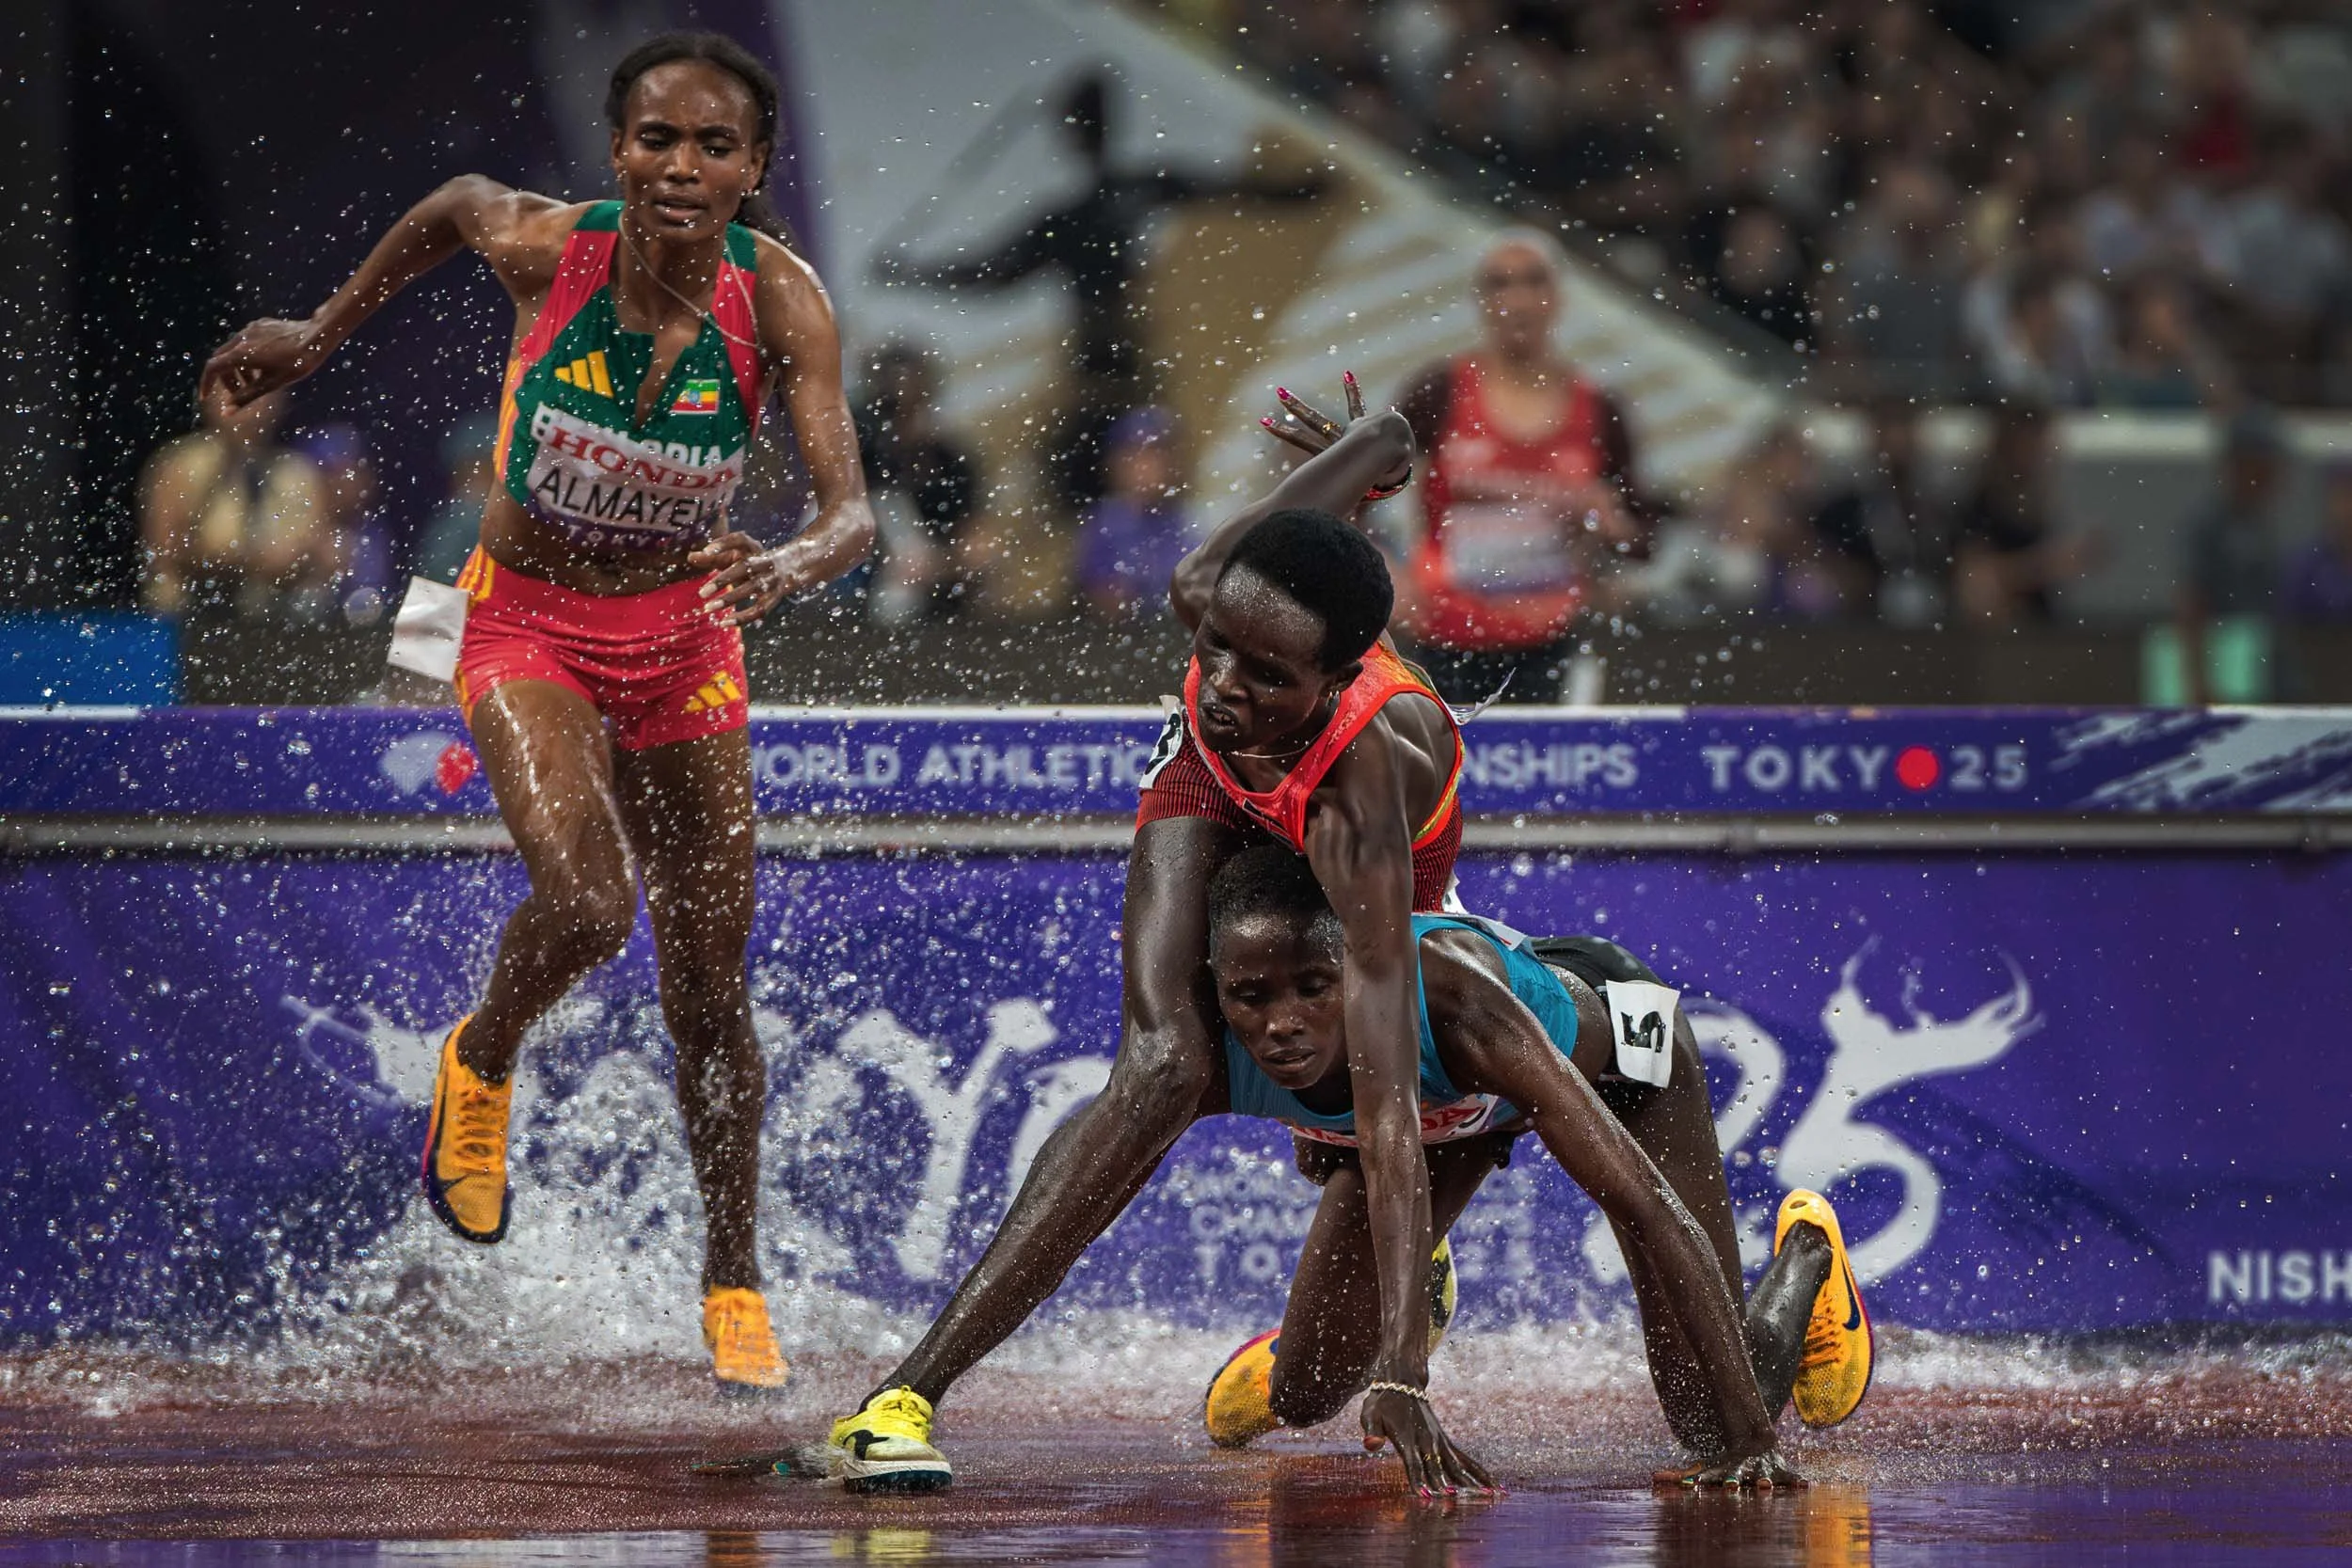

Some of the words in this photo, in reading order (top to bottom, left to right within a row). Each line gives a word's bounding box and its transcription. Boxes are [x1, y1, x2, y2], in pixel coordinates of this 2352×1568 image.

[548, 426, 736, 489] HONDA
[917, 744, 1157, 788] ATHLETIC
[1947, 745, 2028, 790] 25
[1620, 1010, 1667, 1053] 5
